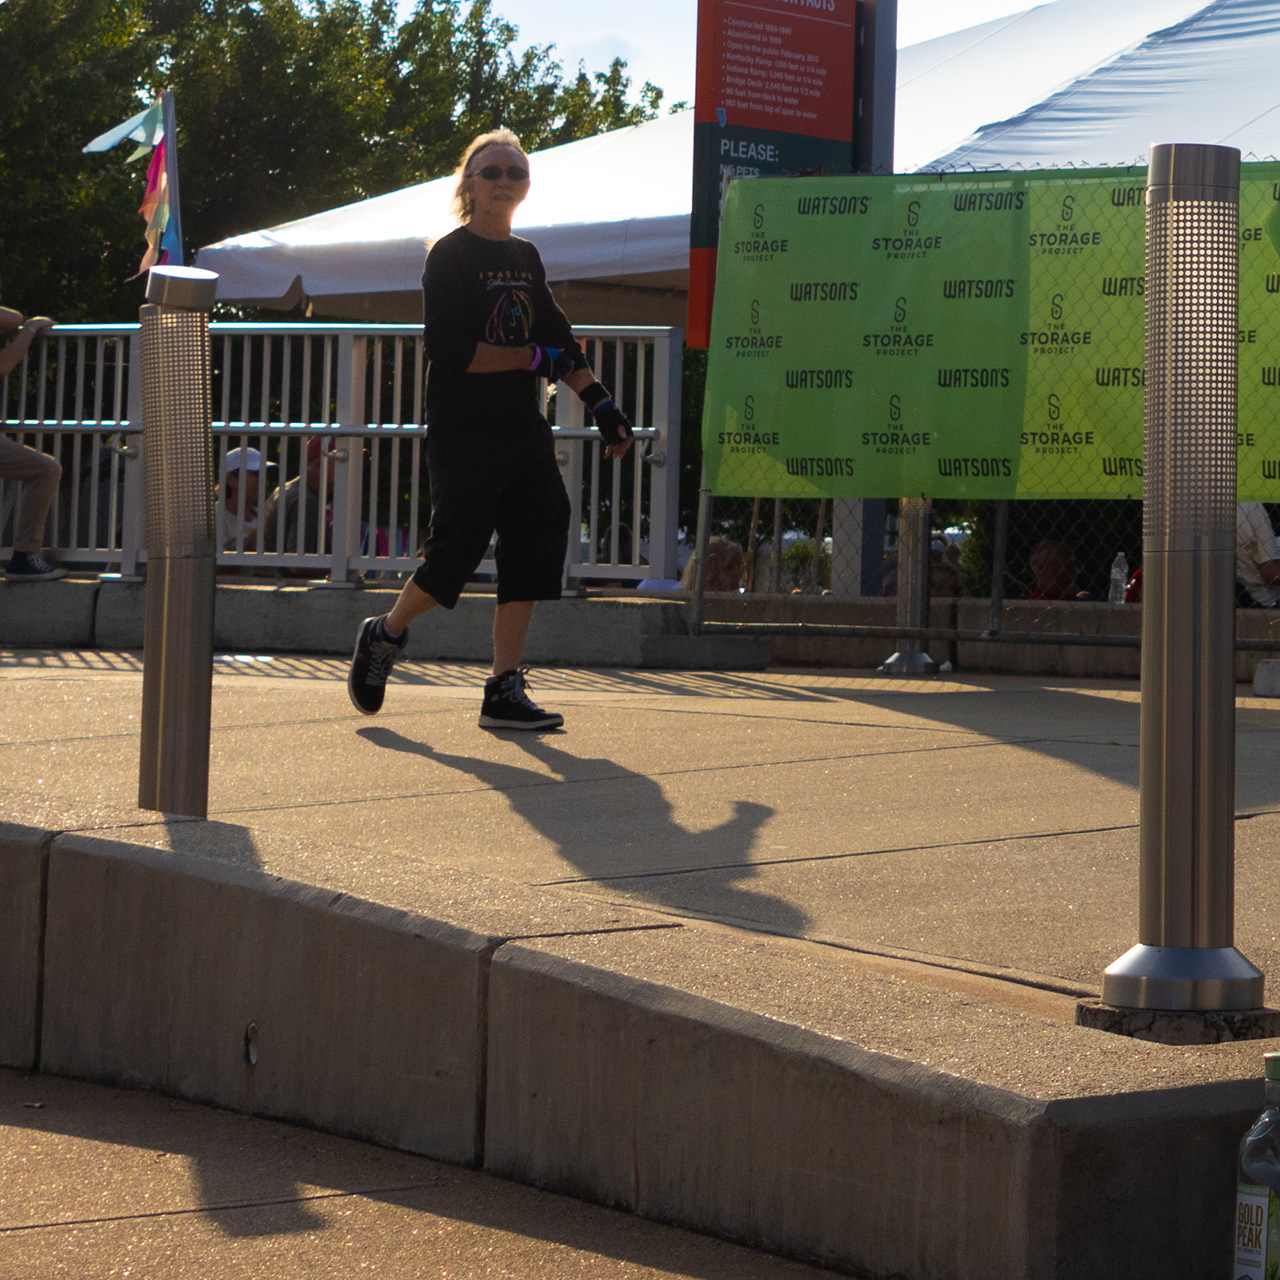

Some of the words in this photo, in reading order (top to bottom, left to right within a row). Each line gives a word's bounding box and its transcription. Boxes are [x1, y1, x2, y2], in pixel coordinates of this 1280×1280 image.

[720, 138, 779, 162] PLEASE:
[798, 197, 868, 214] WATSON'S
[954, 192, 1024, 211] WATSON'S
[735, 240, 787, 253] STORAGE
[872, 237, 940, 250] STORAGE
[1029, 232, 1100, 246] STORAGE
[791, 283, 857, 301] WATSON'S
[944, 279, 1014, 298] WATSON'S
[726, 336, 781, 348] STORAGE
[863, 335, 932, 347] STORAGE
[1020, 332, 1090, 345] STORAGE
[787, 370, 852, 388] WATSON'S
[938, 369, 1009, 387] WATSON'S
[719, 433, 779, 444] STORAGE
[862, 433, 929, 445] STORAGE
[1020, 432, 1093, 444] STORAGE
[787, 458, 853, 476] WATSON'S
[939, 459, 1011, 476] WATSON'S
[1238, 1202, 1263, 1227] GOLD
[1237, 1224, 1262, 1249] PEAK
